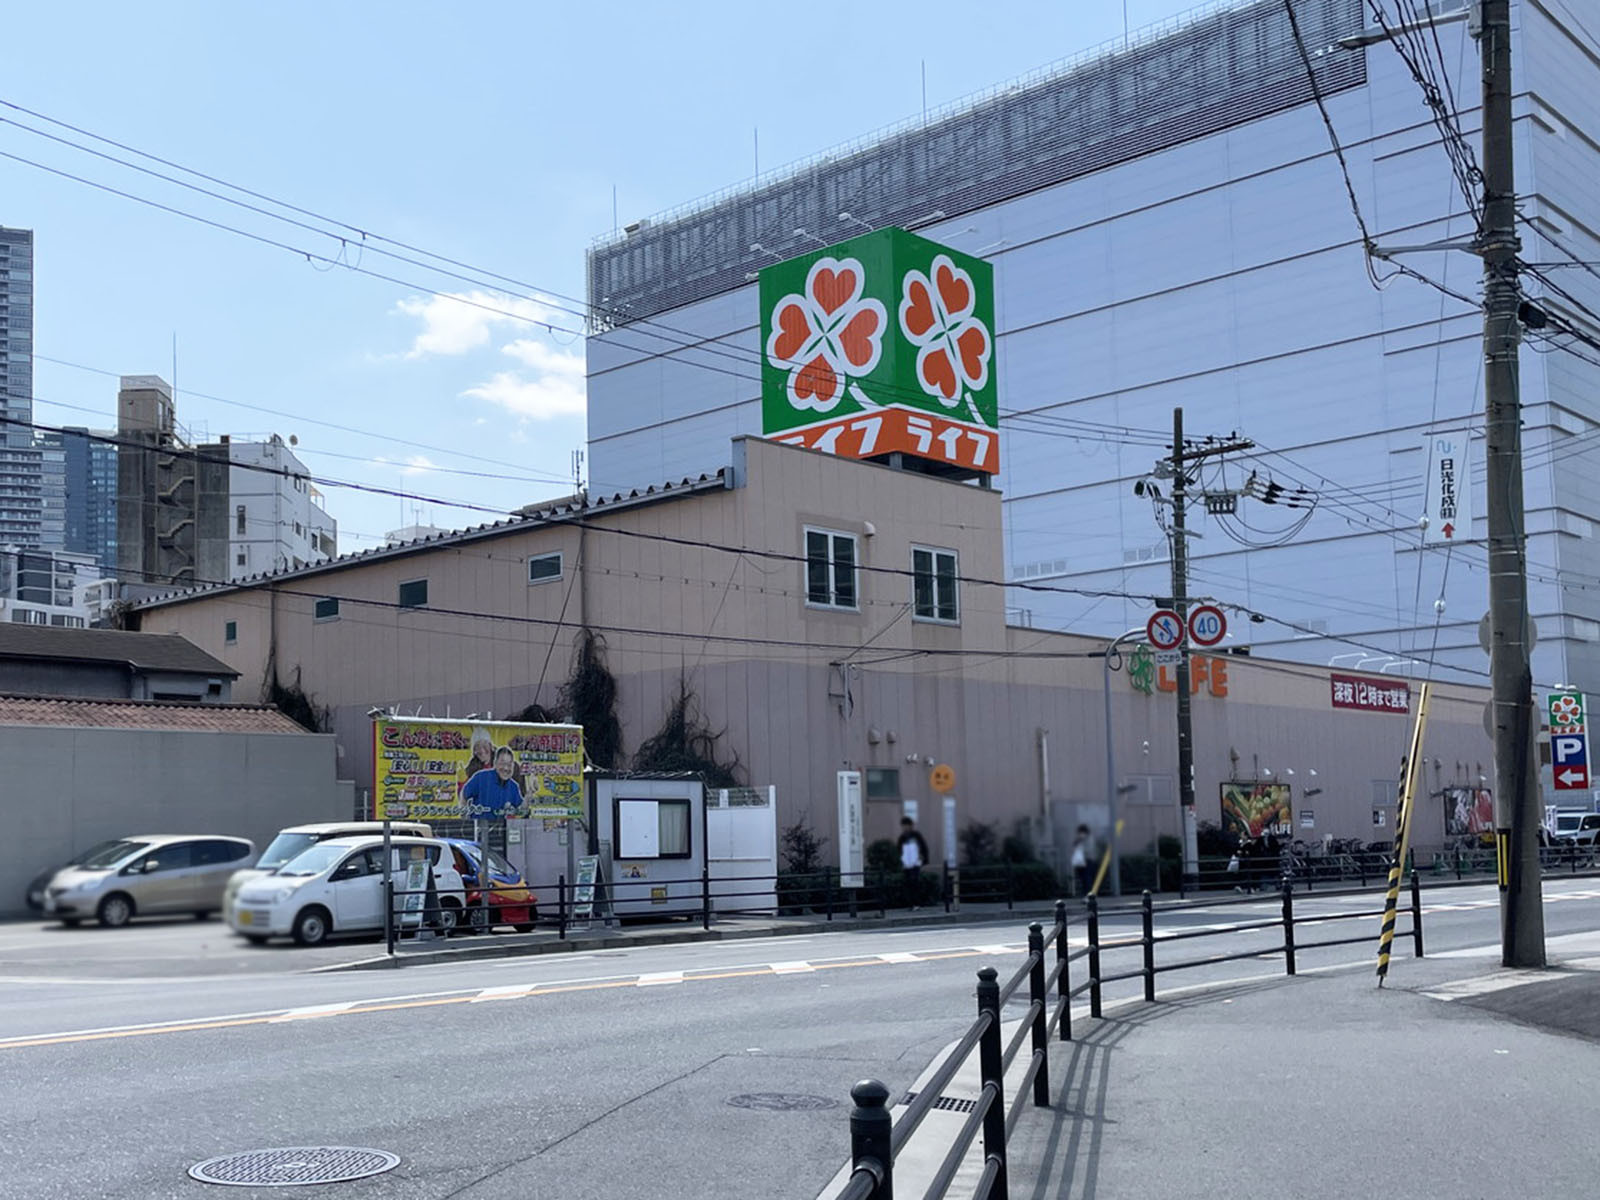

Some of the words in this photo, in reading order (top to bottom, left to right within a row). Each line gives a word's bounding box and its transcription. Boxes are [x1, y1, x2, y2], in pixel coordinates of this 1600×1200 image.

[779, 416, 883, 455] イフ
[907, 416, 990, 467] ライフ
[1197, 616, 1219, 635] 40
[1158, 654, 1228, 698] LFE
[1333, 681, 1409, 709] 深夜12時まで営業
[1557, 738, 1582, 763] P
